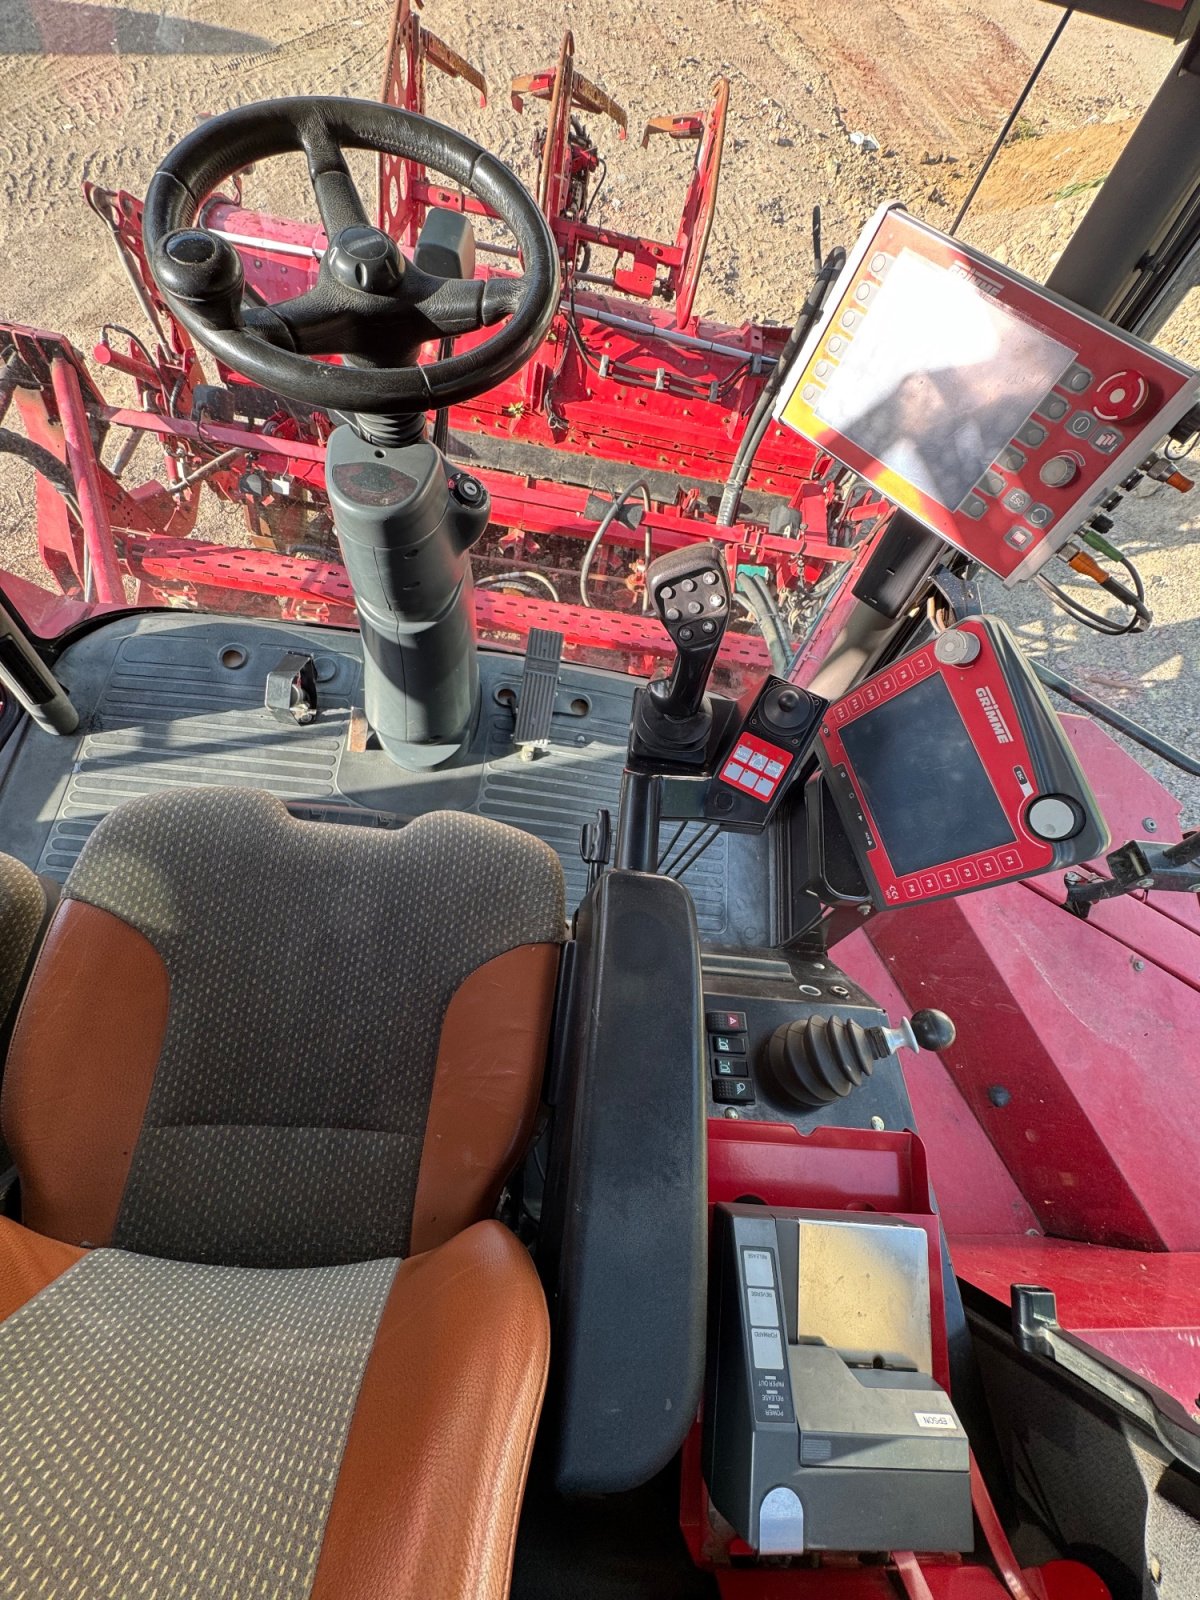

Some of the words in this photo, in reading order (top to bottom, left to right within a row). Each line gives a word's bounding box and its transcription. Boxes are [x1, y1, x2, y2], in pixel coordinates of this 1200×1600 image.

[1010, 493, 1024, 507] ESC
[917, 659, 925, 668] F7
[1016, 770, 1025, 781] ESC
[1005, 855, 1014, 866] F1
[984, 862, 992, 872] F2
[753, 1331, 778, 1339] FORWARD
[769, 1380, 785, 1388] PAPER
[761, 1394, 785, 1402] RELEASE
[764, 1409, 784, 1417] POWER
[922, 1416, 948, 1425] EPSON
